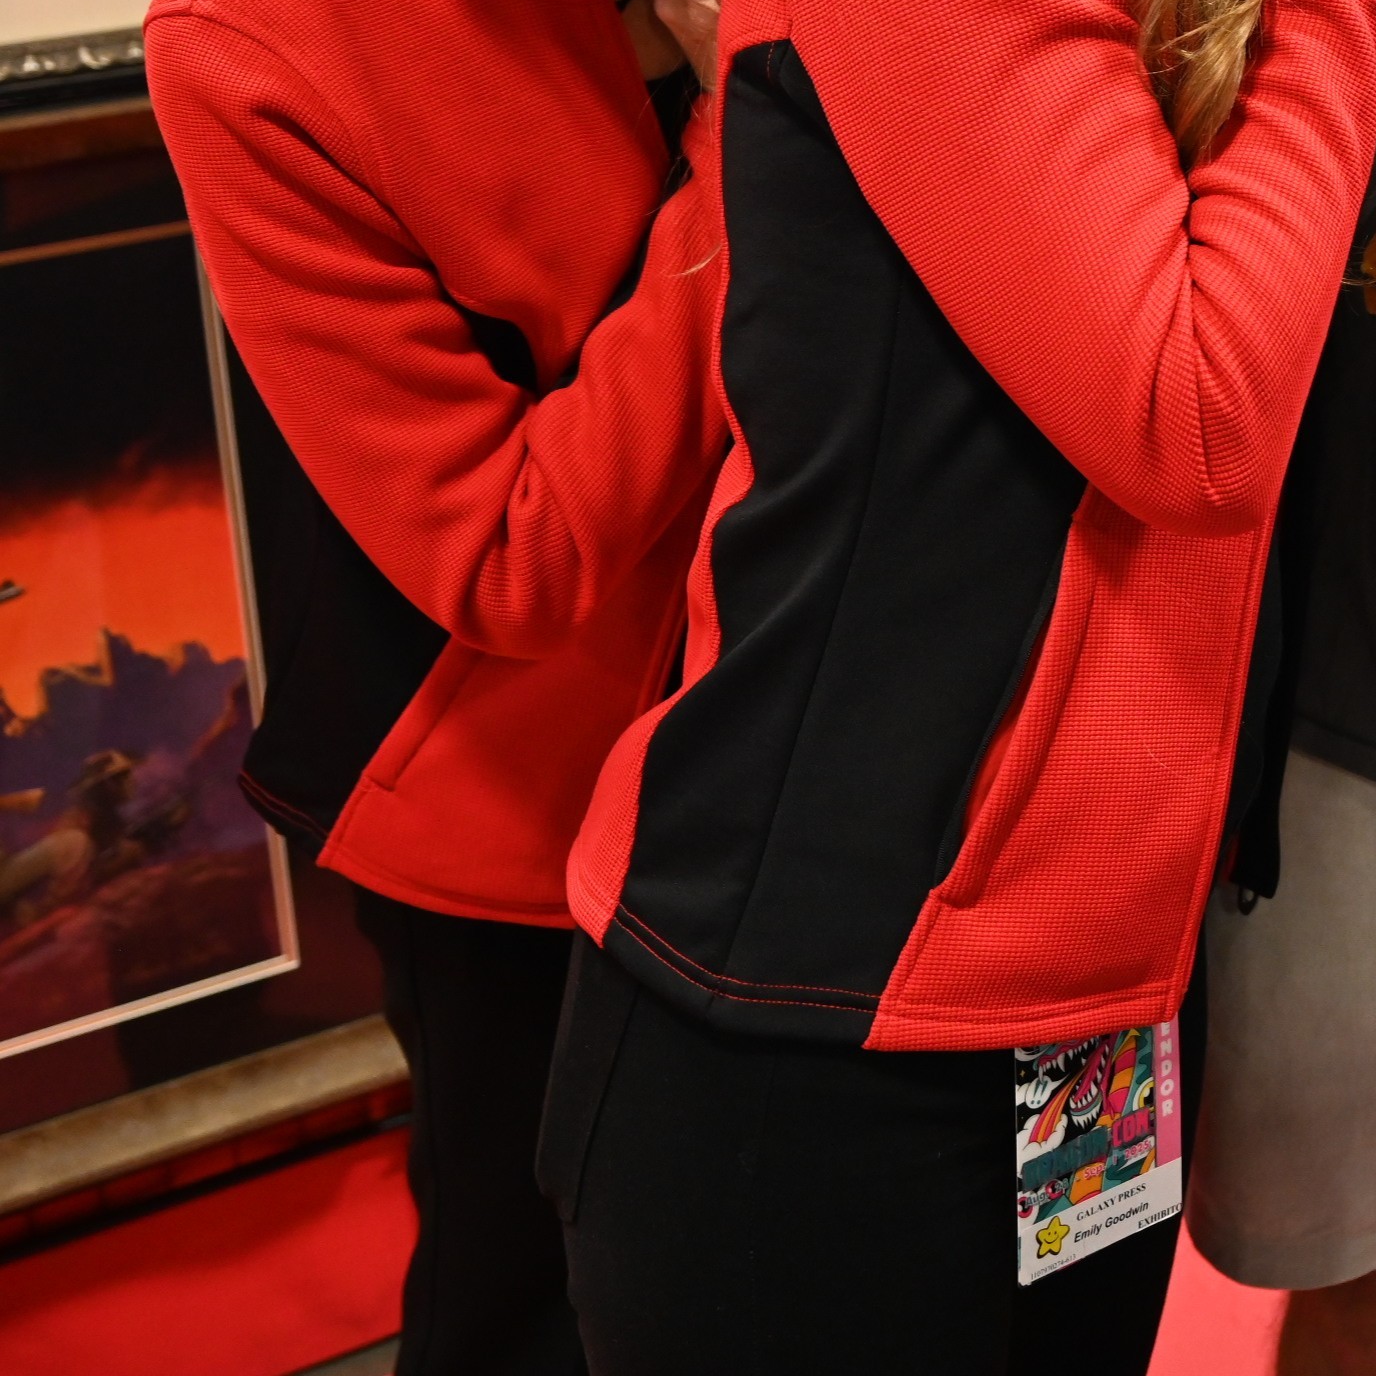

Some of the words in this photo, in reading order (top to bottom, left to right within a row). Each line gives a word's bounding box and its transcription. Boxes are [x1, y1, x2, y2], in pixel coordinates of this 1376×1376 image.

[1160, 1021, 1174, 1117] ENDOR
[1112, 1110, 1150, 1147] CON
[1125, 1140, 1151, 1160] 2025
[1077, 1196, 1116, 1222] GALAXY
[1118, 1183, 1146, 1203] PRESS
[1138, 1203, 1183, 1229] EXHIBITO
[1074, 1224, 1102, 1243] Emily
[1105, 1201, 1149, 1228] Goodwin
